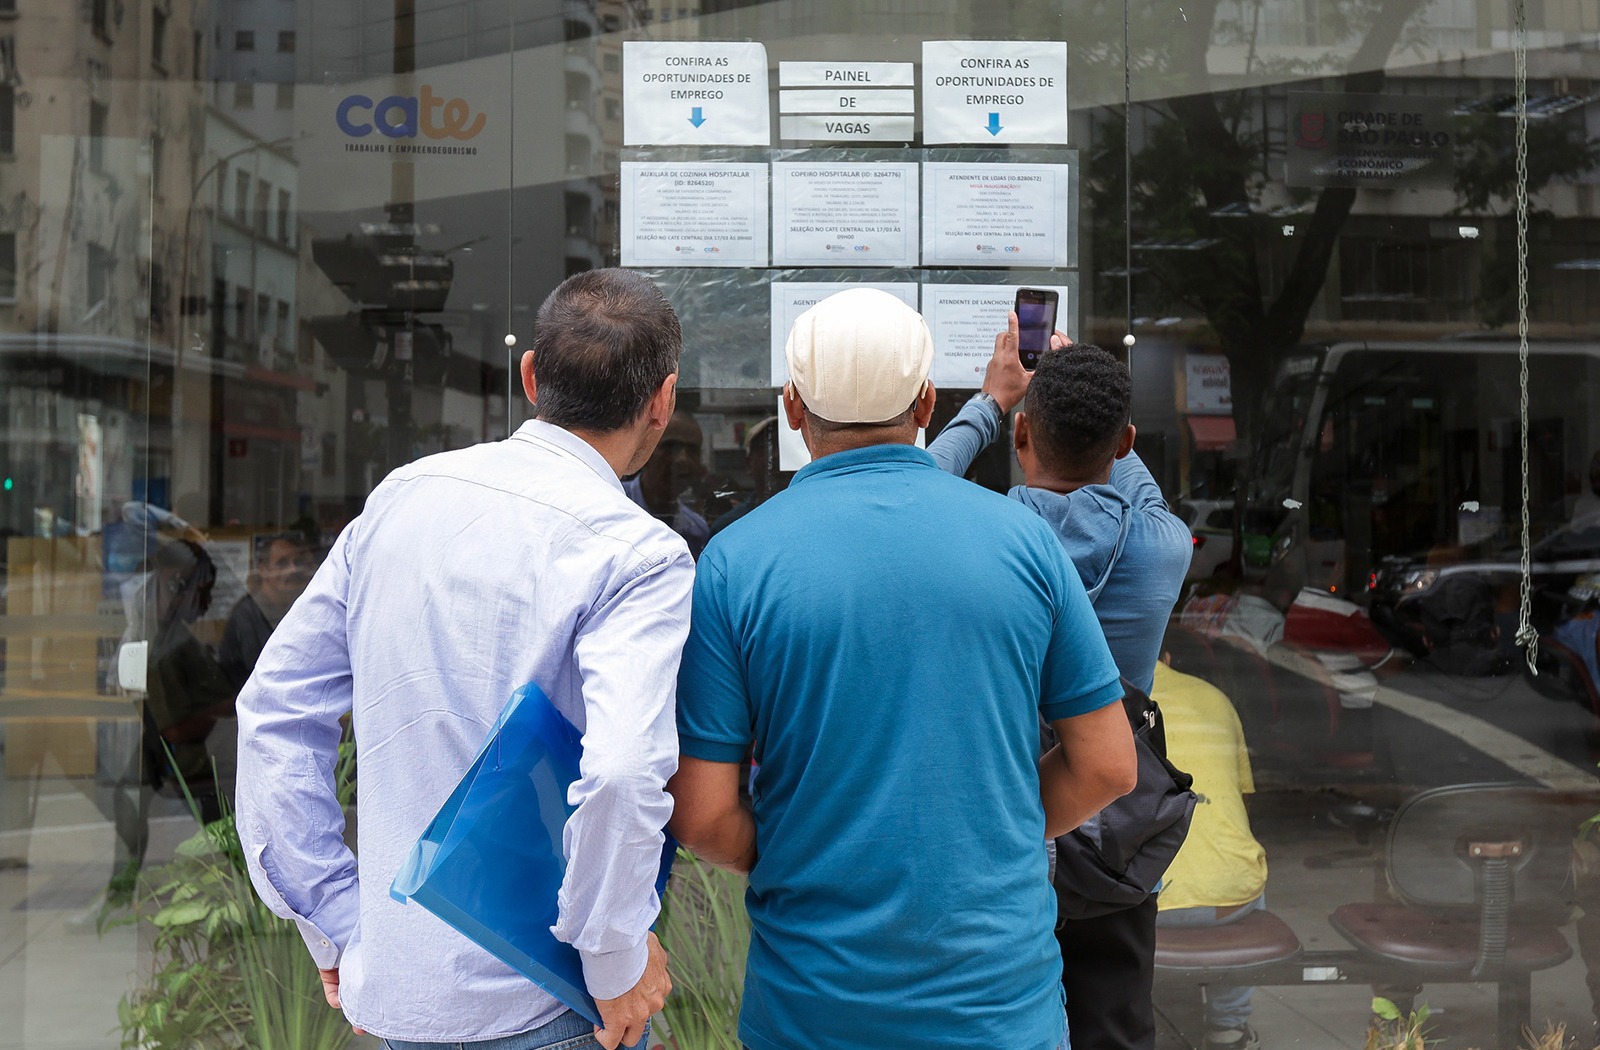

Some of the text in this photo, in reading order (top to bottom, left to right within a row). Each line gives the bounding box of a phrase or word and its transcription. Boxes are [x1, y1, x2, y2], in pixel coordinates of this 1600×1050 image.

[665, 56, 729, 67] CONFIRA AS
[960, 58, 1029, 69] CONFIRA AS
[642, 73, 751, 84] OPORTUNIDADES DE
[825, 70, 871, 82] PAINEL
[935, 75, 1054, 88] OPORTUNIDADES DE
[670, 90, 724, 100] EMPREGO
[966, 94, 1024, 106] EMPREGO
[840, 96, 856, 108] DE
[336, 84, 486, 140] cate
[1338, 112, 1422, 126] CIDADE DE
[825, 122, 870, 135] VAGAS
[1337, 128, 1450, 146] SÃO PAULO
[345, 144, 477, 155] TRABALHO E EMPREENDEDORISMO
